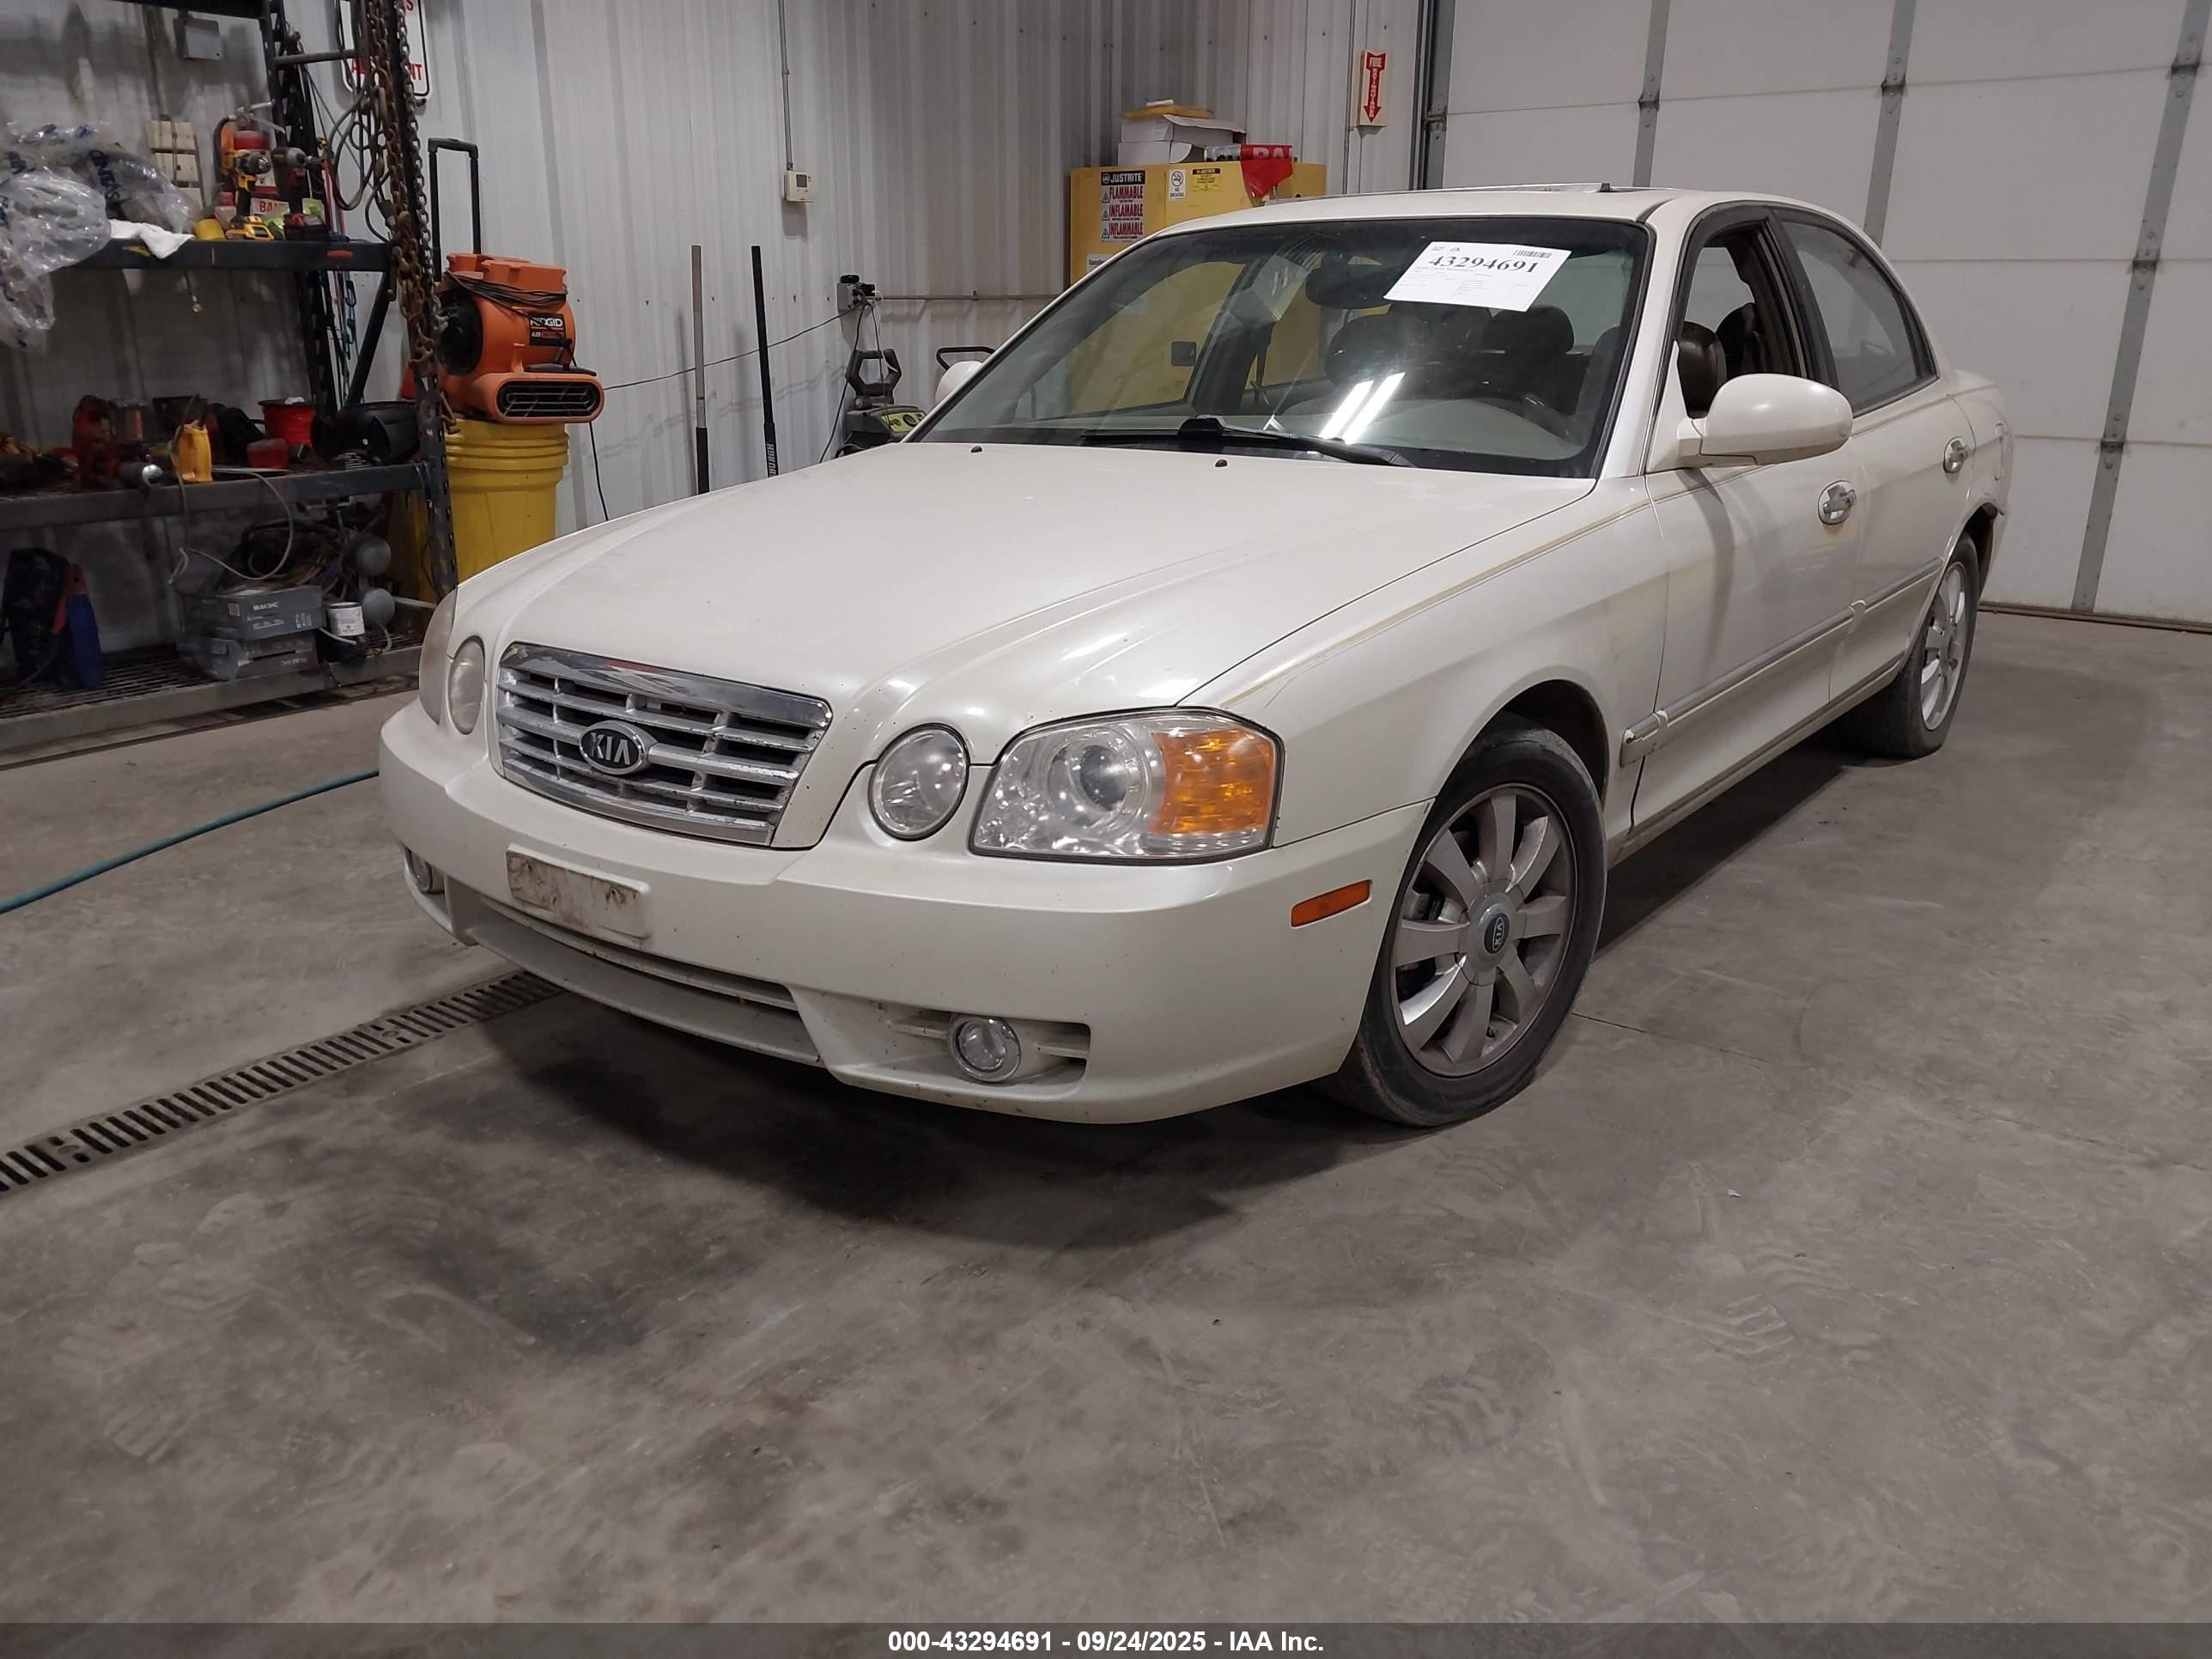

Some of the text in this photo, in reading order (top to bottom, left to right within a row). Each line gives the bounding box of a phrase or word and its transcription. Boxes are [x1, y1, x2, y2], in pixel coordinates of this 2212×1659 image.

[1110, 173, 1142, 183] JUSTRITE
[1109, 185, 1143, 199] FLAMMABLE
[1429, 256, 1539, 273] 43294691
[590, 732, 631, 765] KIA
[1494, 922, 1504, 945] KIA
